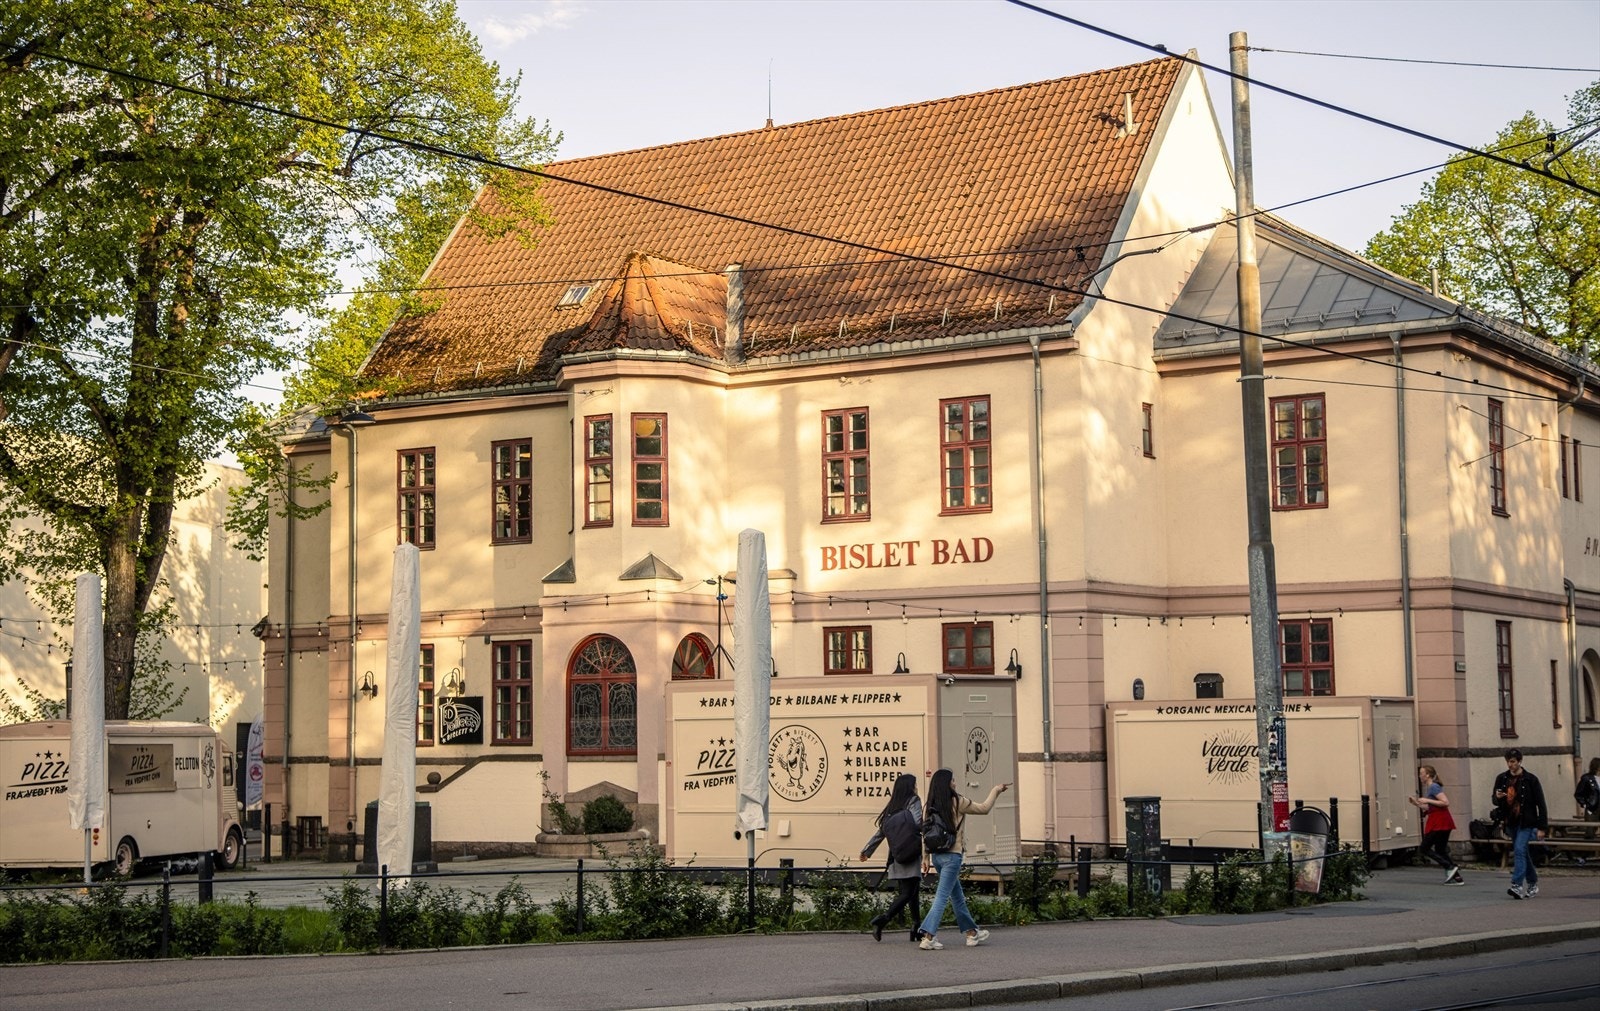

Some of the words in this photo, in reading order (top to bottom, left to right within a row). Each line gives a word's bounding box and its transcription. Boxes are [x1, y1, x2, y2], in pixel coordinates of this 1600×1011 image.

[820, 540, 920, 571] BISLET
[931, 537, 994, 565] BAD
[708, 697, 728, 707] BAR
[796, 694, 837, 705] BILBANE
[852, 693, 891, 704] FLIPPER
[1165, 705, 1211, 715] ORGANIC
[794, 729, 818, 745] BISLETT
[855, 727, 879, 737] BAR
[856, 741, 908, 752] ARCADE
[1202, 737, 1259, 759] Vaquera
[130, 753, 154, 770] PIZZA
[175, 757, 199, 770] PELOTON
[697, 749, 736, 770] PIZZ
[856, 756, 906, 767] BILBANE
[1208, 755, 1249, 774] Verde
[809, 757, 825, 792] POLLETT
[683, 780, 700, 791] FRA
[703, 775, 737, 788] VEDFYR
[774, 781, 799, 797] BISLETT
[5, 790, 23, 801] FRA
[856, 786, 892, 797] PIZZA
